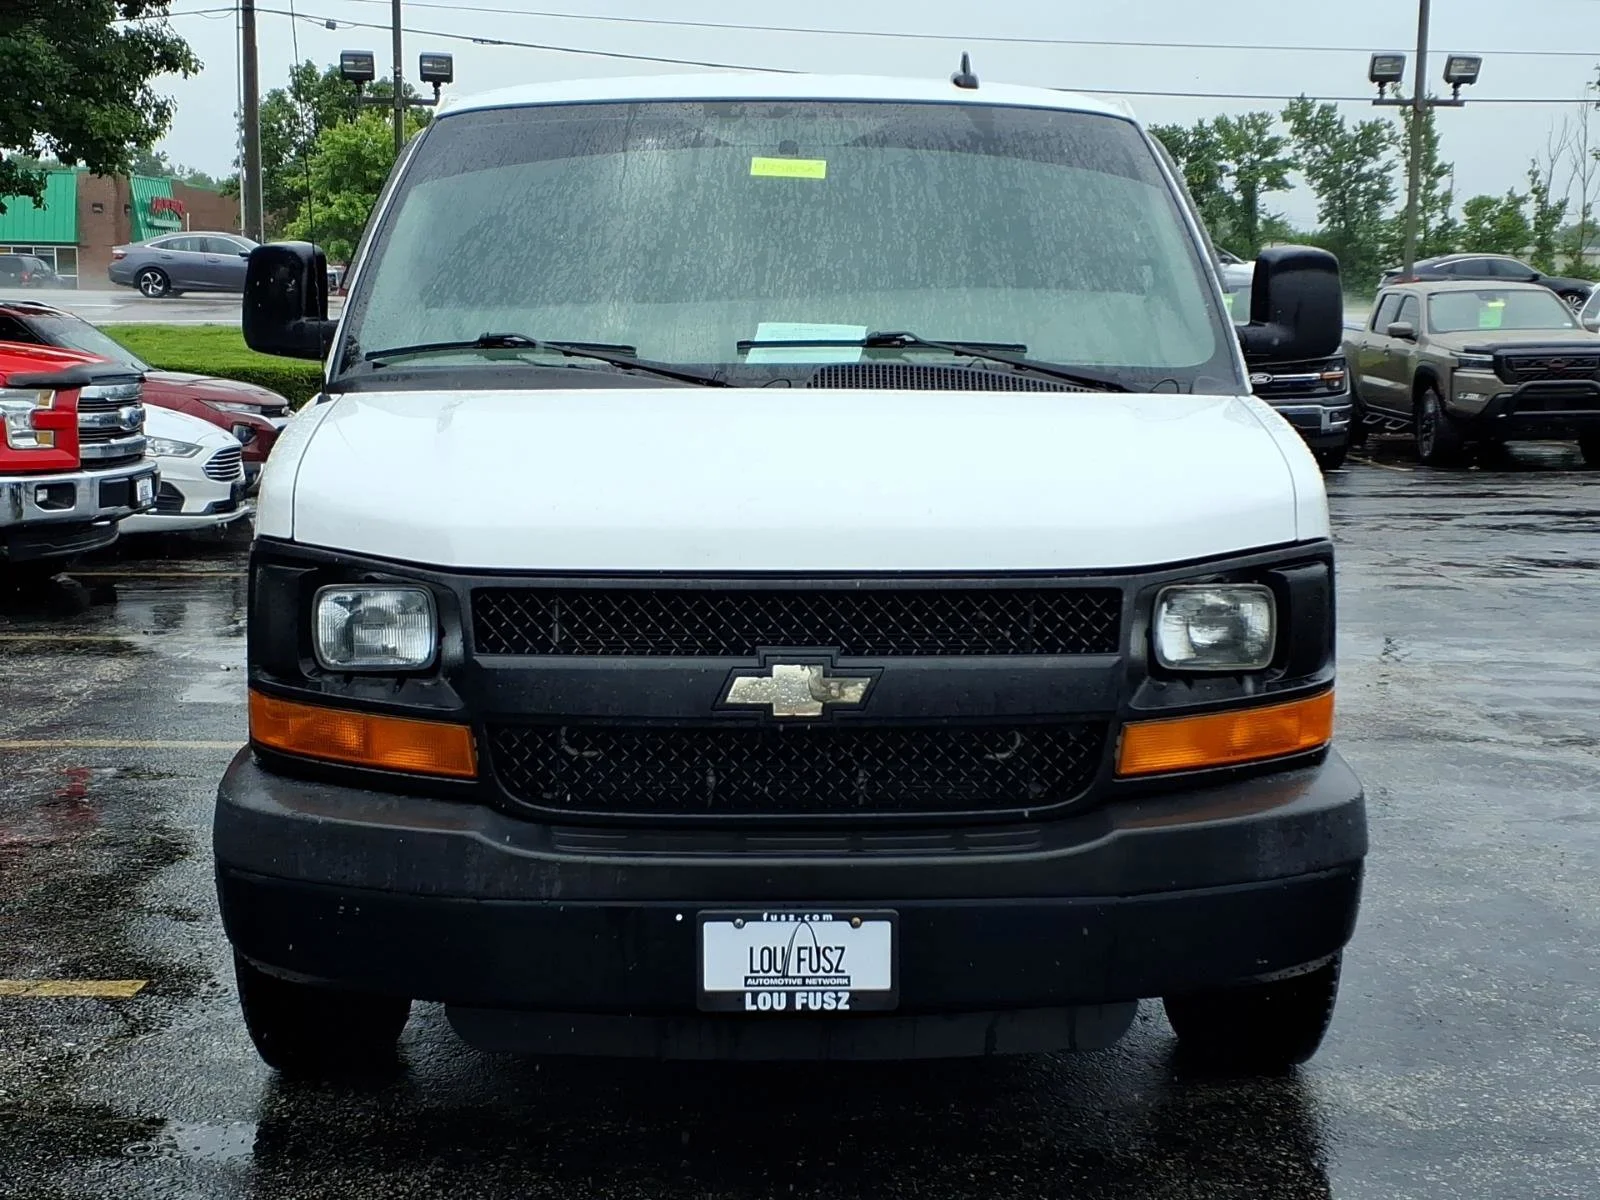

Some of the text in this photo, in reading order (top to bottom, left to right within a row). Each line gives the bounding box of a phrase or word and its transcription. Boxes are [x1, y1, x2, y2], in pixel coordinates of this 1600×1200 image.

[763, 912, 833, 922] fusz.com
[749, 946, 846, 974] LOU FUSZ
[746, 977, 849, 985] AUTOMOTIVE NETWORK
[745, 991, 850, 1011] LOU FUSZ
